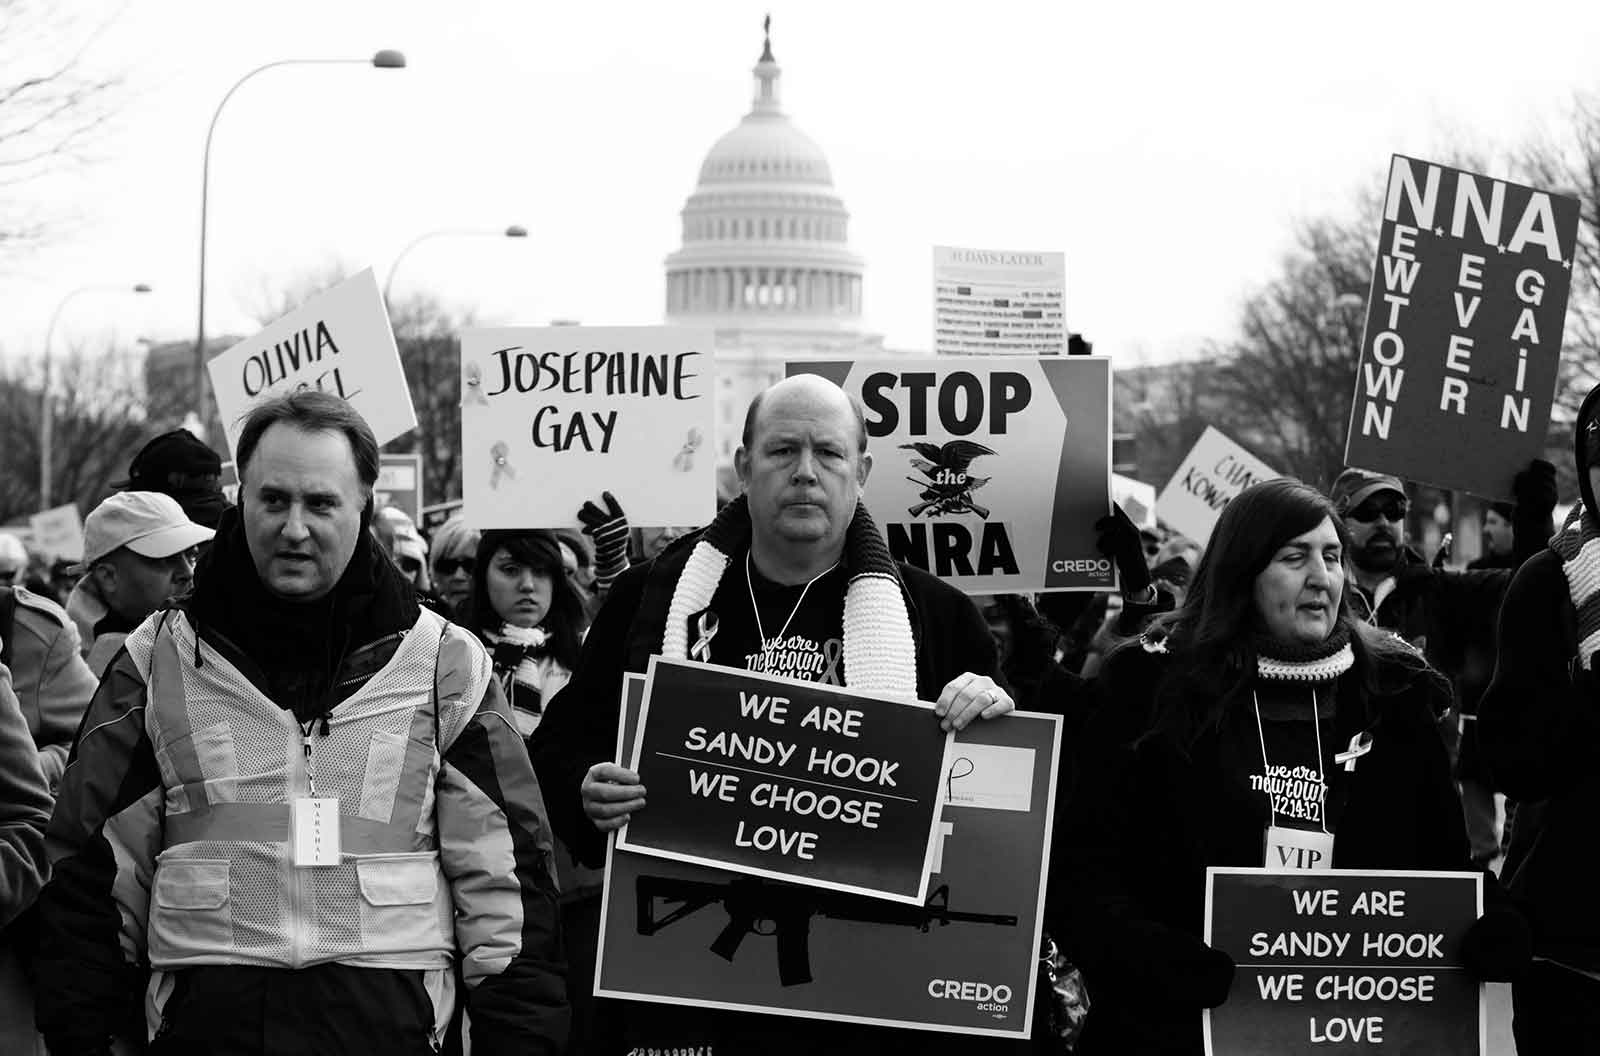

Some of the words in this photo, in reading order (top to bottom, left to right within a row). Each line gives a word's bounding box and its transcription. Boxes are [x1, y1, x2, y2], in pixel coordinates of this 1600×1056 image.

[1000, 254, 1044, 266] LATER
[242, 319, 340, 397] OLIVIA
[487, 345, 704, 400] JOSEPHINE
[861, 370, 1032, 437] STOP
[532, 405, 618, 453] GAY
[935, 468, 967, 485] the
[886, 522, 1021, 577] NRA
[1051, 559, 1111, 573] CREDO
[787, 634, 819, 652] are
[744, 649, 825, 674] newtown
[738, 690, 790, 725] WE
[800, 705, 864, 738] ARE
[684, 726, 797, 767] SANDY
[807, 746, 900, 787] HOOK
[1264, 764, 1292, 779] we
[1292, 765, 1322, 783] are
[689, 768, 740, 802] WE
[750, 783, 883, 829] CHOOSE
[735, 820, 819, 860] LOVE
[1275, 845, 1322, 869] VIP
[1292, 889, 1339, 916] WE
[1350, 890, 1406, 917] ARE
[1249, 931, 1351, 957] SANDY
[1362, 932, 1444, 958] HOOK
[927, 978, 1013, 1004] CREDO
[1256, 974, 1304, 1001] WE
[1315, 975, 1435, 1002] CHOOSE
[976, 1002, 1009, 1013] action
[1309, 1016, 1384, 1043] LOVE
